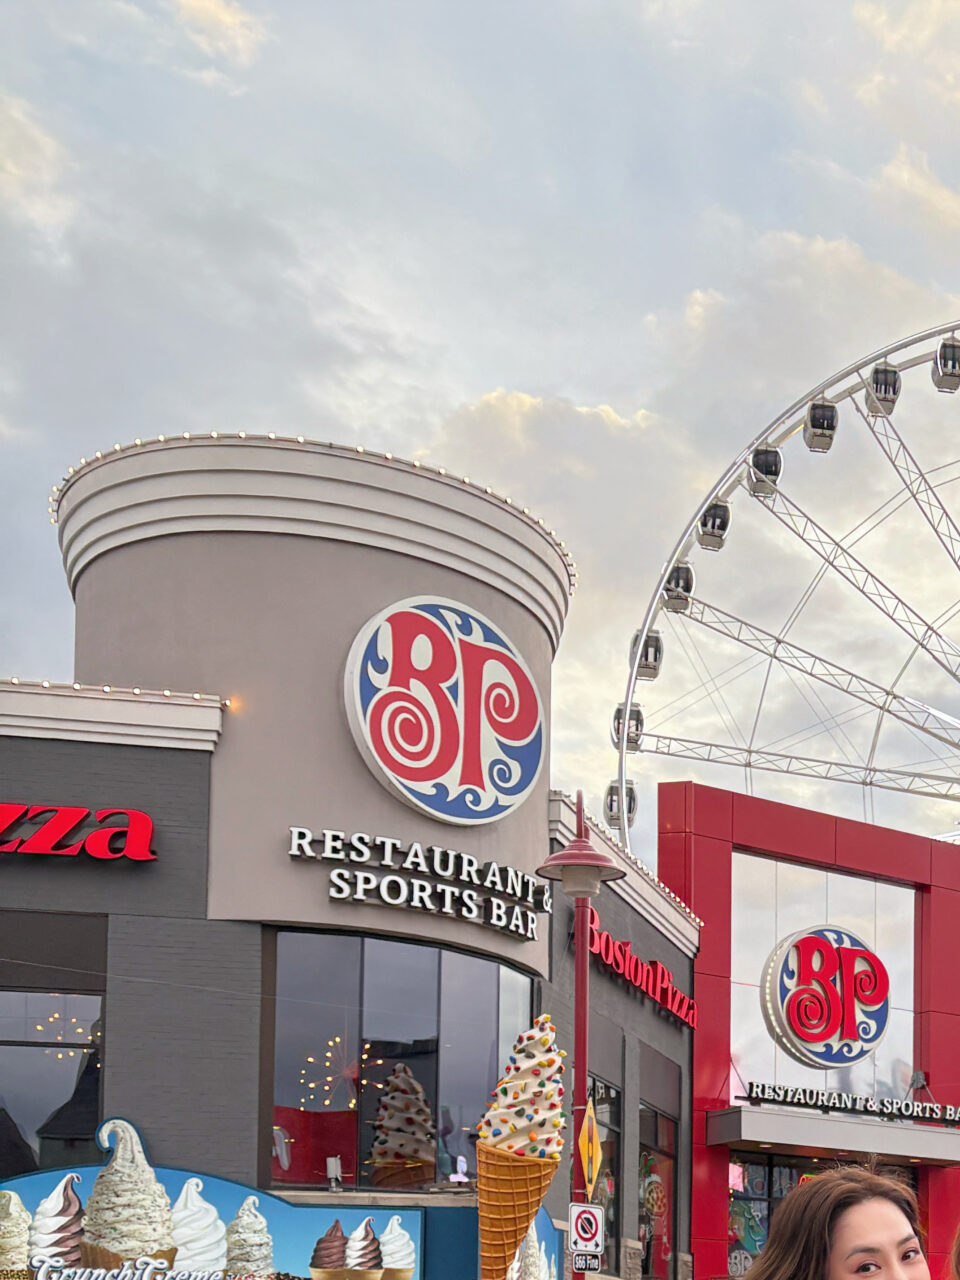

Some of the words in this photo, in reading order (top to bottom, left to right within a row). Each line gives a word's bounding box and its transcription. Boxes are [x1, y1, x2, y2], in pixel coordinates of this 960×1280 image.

[288, 826, 537, 903] RESTAURANT
[329, 868, 479, 919] SPORTS
[490, 896, 538, 941] BAR
[751, 1082, 863, 1111] RESTAURANT
[866, 1098, 878, 1112] &
[883, 1098, 942, 1119] SPORTS
[587, 1255, 599, 1269] Fine
